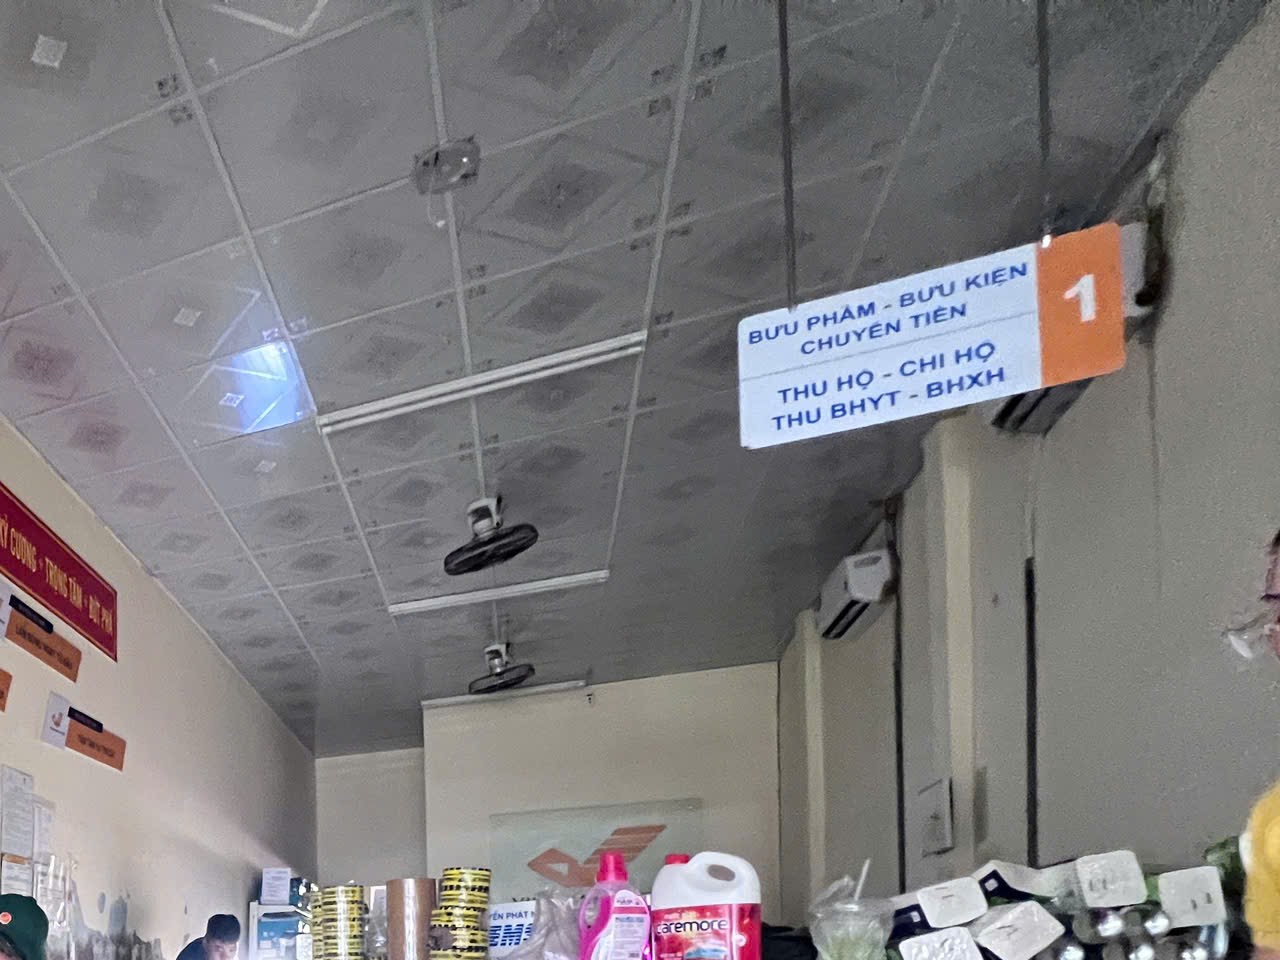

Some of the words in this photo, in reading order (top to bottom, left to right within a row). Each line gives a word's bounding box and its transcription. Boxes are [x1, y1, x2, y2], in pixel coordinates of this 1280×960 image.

[749, 321, 799, 345] BƯU
[899, 280, 956, 308] BƯU
[965, 262, 1028, 292] KIỆN
[1063, 273, 1097, 322] 1
[772, 407, 821, 431] THU
[831, 389, 901, 420] BHYT
[926, 367, 1006, 399] BHXH
[778, 380, 828, 404] THU
[836, 369, 874, 392] HỘ
[899, 353, 945, 377] CHI
[954, 340, 996, 364] HỘ
[656, 918, 729, 935] caremore
